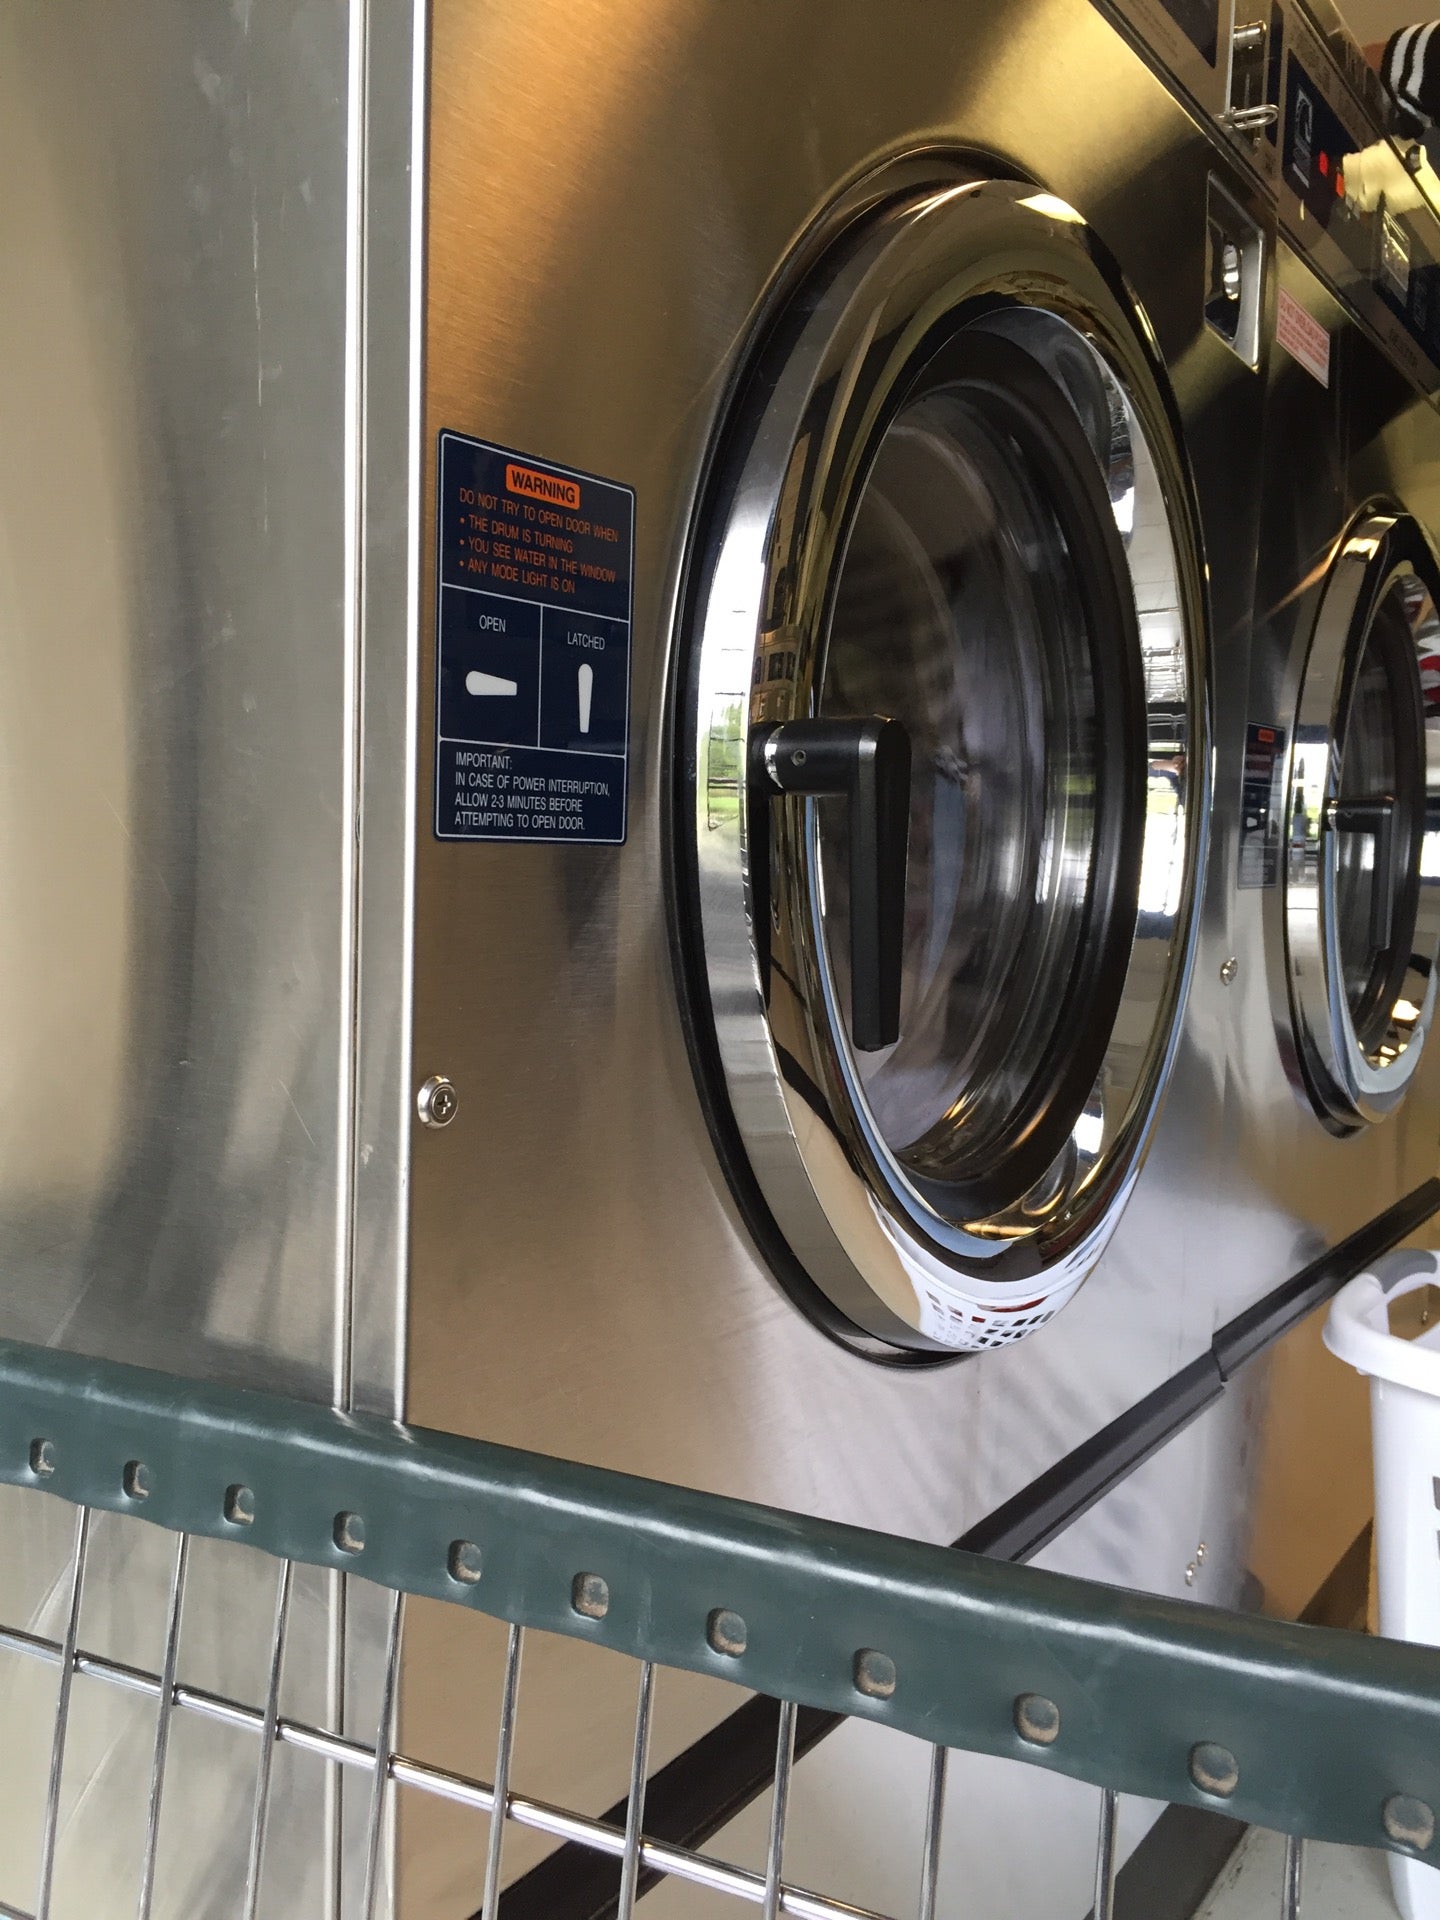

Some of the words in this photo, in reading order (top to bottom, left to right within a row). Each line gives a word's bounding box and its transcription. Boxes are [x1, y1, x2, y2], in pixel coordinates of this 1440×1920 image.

[512, 470, 575, 504] WARNING
[460, 487, 474, 504] DO
[478, 493, 498, 510] NOT
[502, 499, 519, 516] TRY
[524, 505, 535, 521] TO
[539, 510, 563, 528] OPEN
[566, 517, 590, 536] DOOR
[594, 525, 618, 542] WHEN
[469, 514, 488, 532] THE
[492, 520, 518, 540] DRUM
[523, 528, 531, 543] IS
[535, 532, 573, 553] TURNING
[469, 536, 489, 554] YOU
[493, 543, 510, 559] SEE
[515, 548, 545, 566] WATER
[549, 556, 557, 569] IN
[561, 558, 577, 575] THE
[580, 562, 616, 583] WINDOW
[468, 558, 488, 575] ANY
[492, 564, 518, 581] MODE
[522, 570, 547, 587] LIGHT
[551, 576, 559, 591] IS
[562, 578, 575, 594] ON
[479, 615, 506, 632] OPEN
[567, 632, 605, 650] LATCHED
[456, 772, 465, 786] IN
[469, 773, 493, 788] CASE
[497, 775, 509, 789] OF
[513, 776, 545, 792] POWER
[455, 792, 488, 806] ALLOW
[491, 794, 504, 807] 2-3
[507, 796, 546, 810] MINUTES
[549, 797, 582, 812] BEFORE
[455, 812, 513, 827] ATTEMPTING
[517, 814, 529, 828] TO
[532, 815, 556, 829] OPEN
